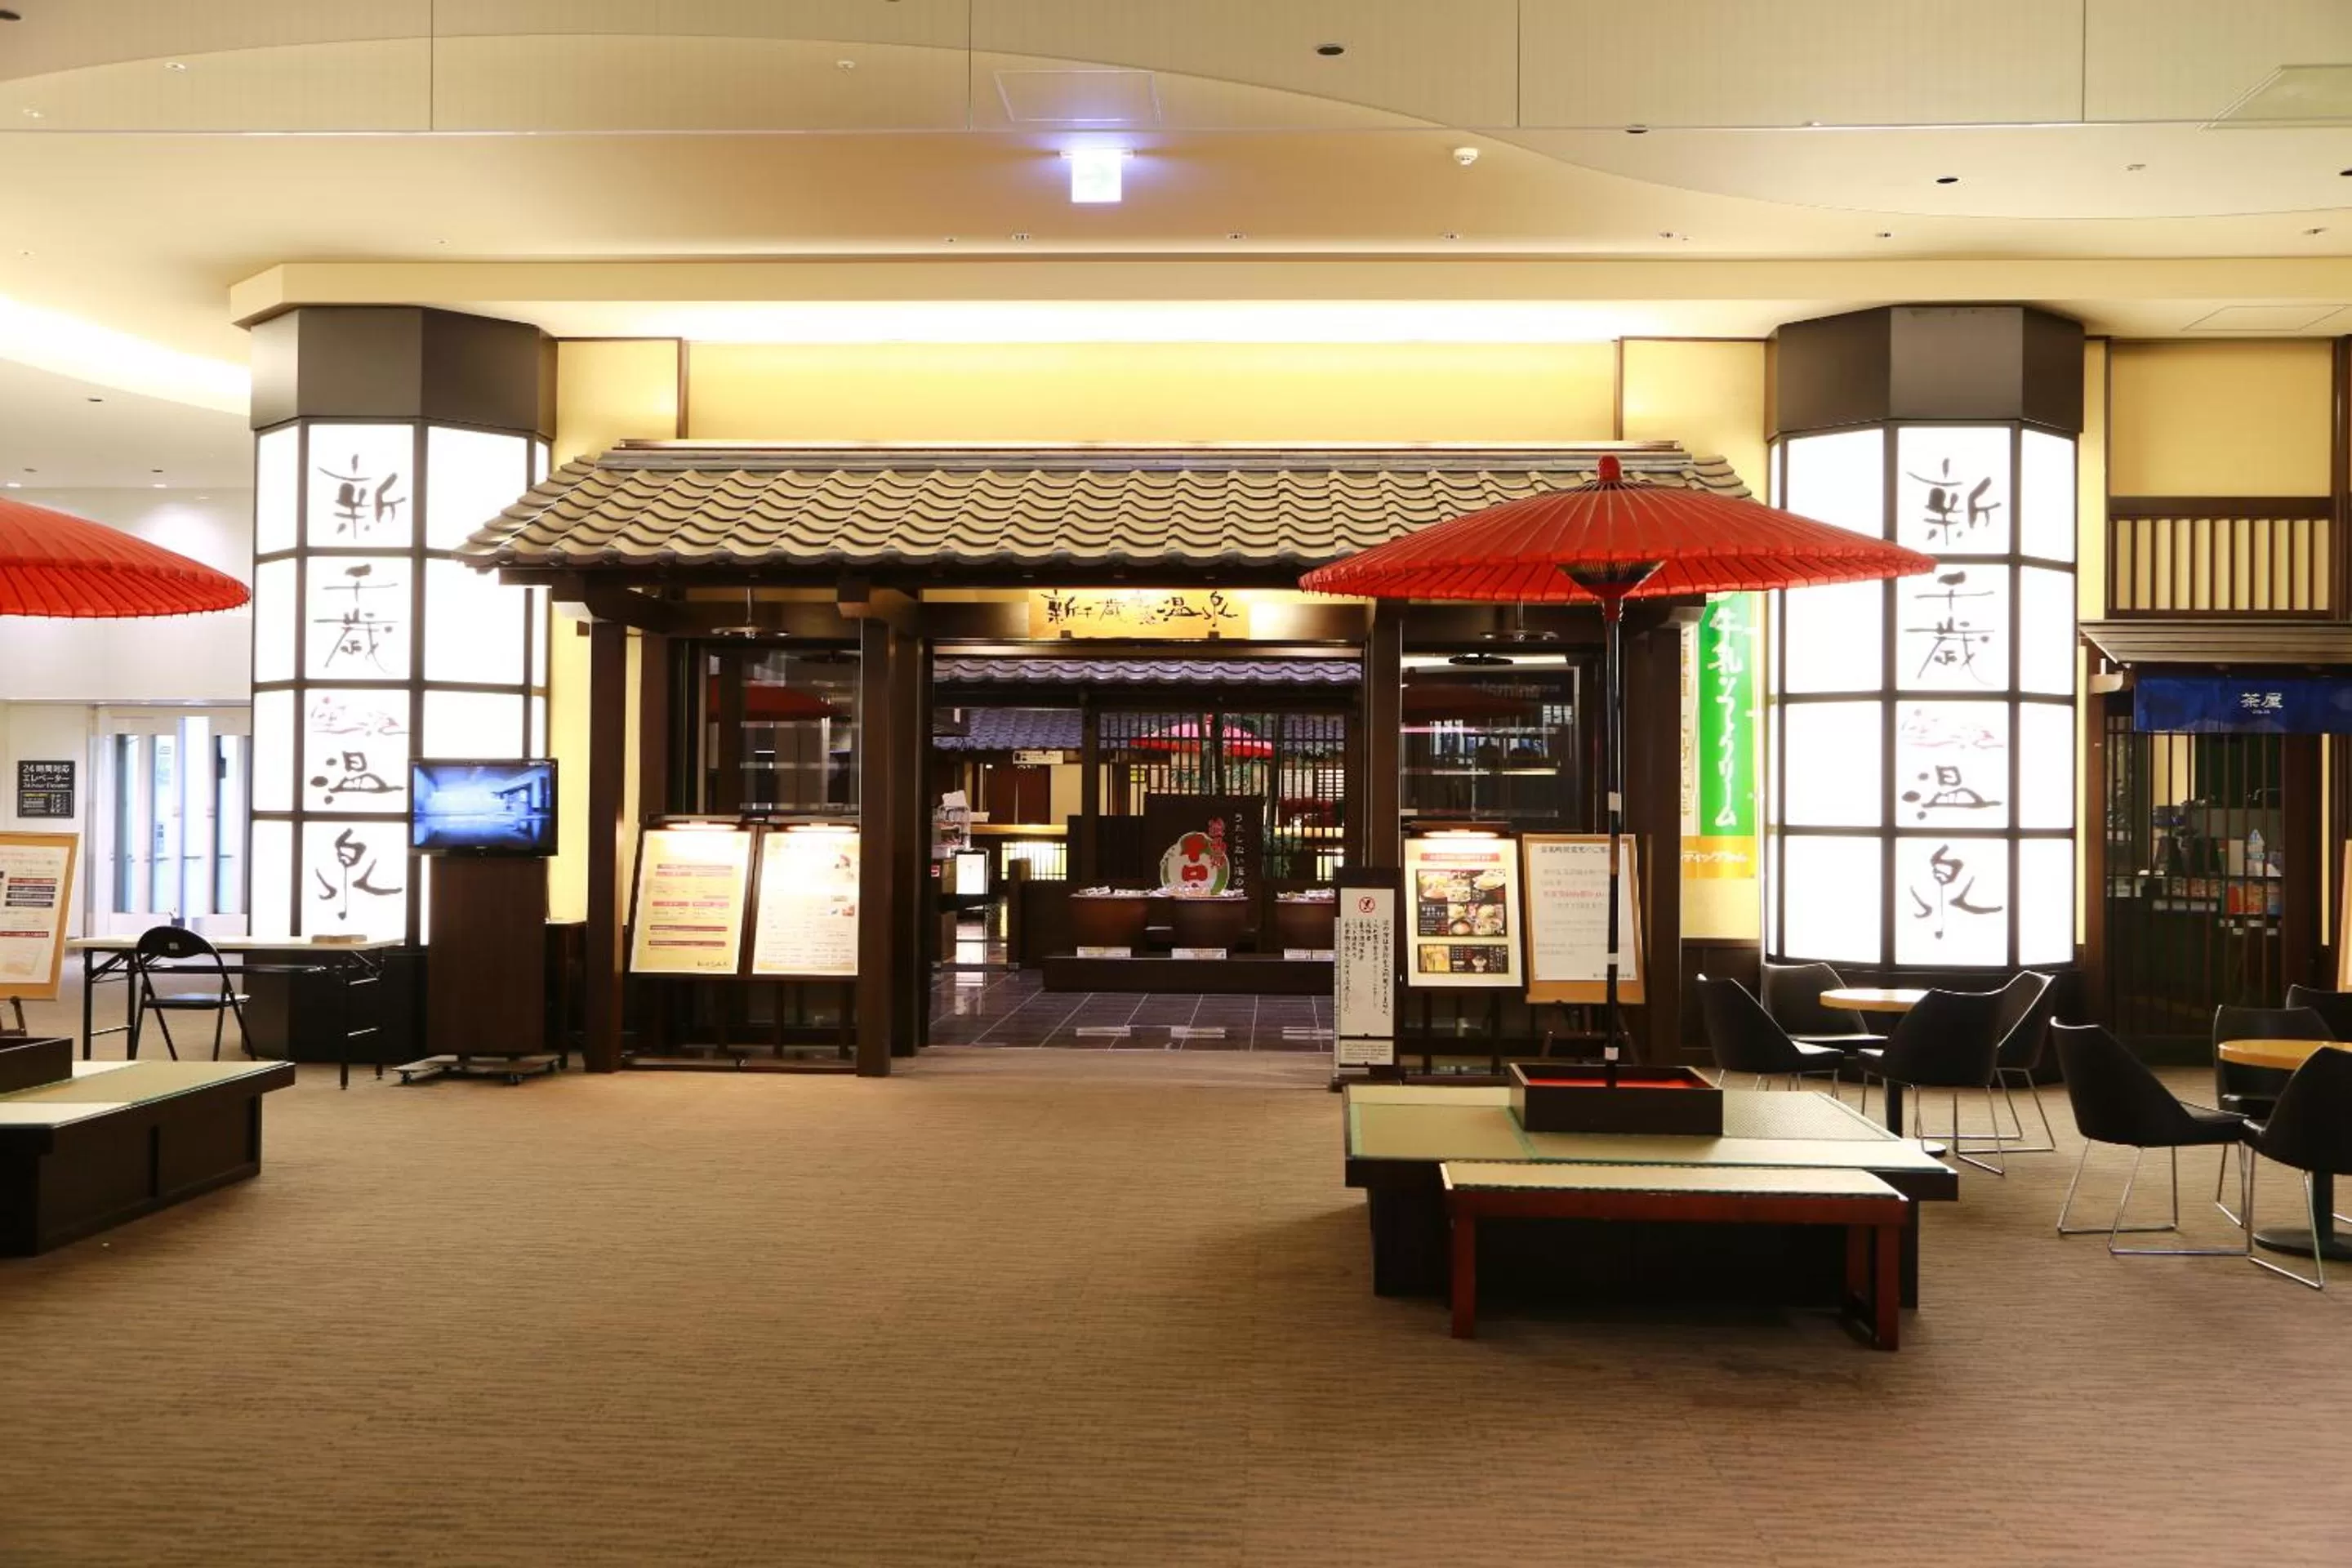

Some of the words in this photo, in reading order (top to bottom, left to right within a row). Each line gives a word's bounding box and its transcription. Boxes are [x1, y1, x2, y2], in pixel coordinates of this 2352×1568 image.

[2240, 692, 2283, 708] 茶屋
[22, 774, 69, 782] エレベーター
